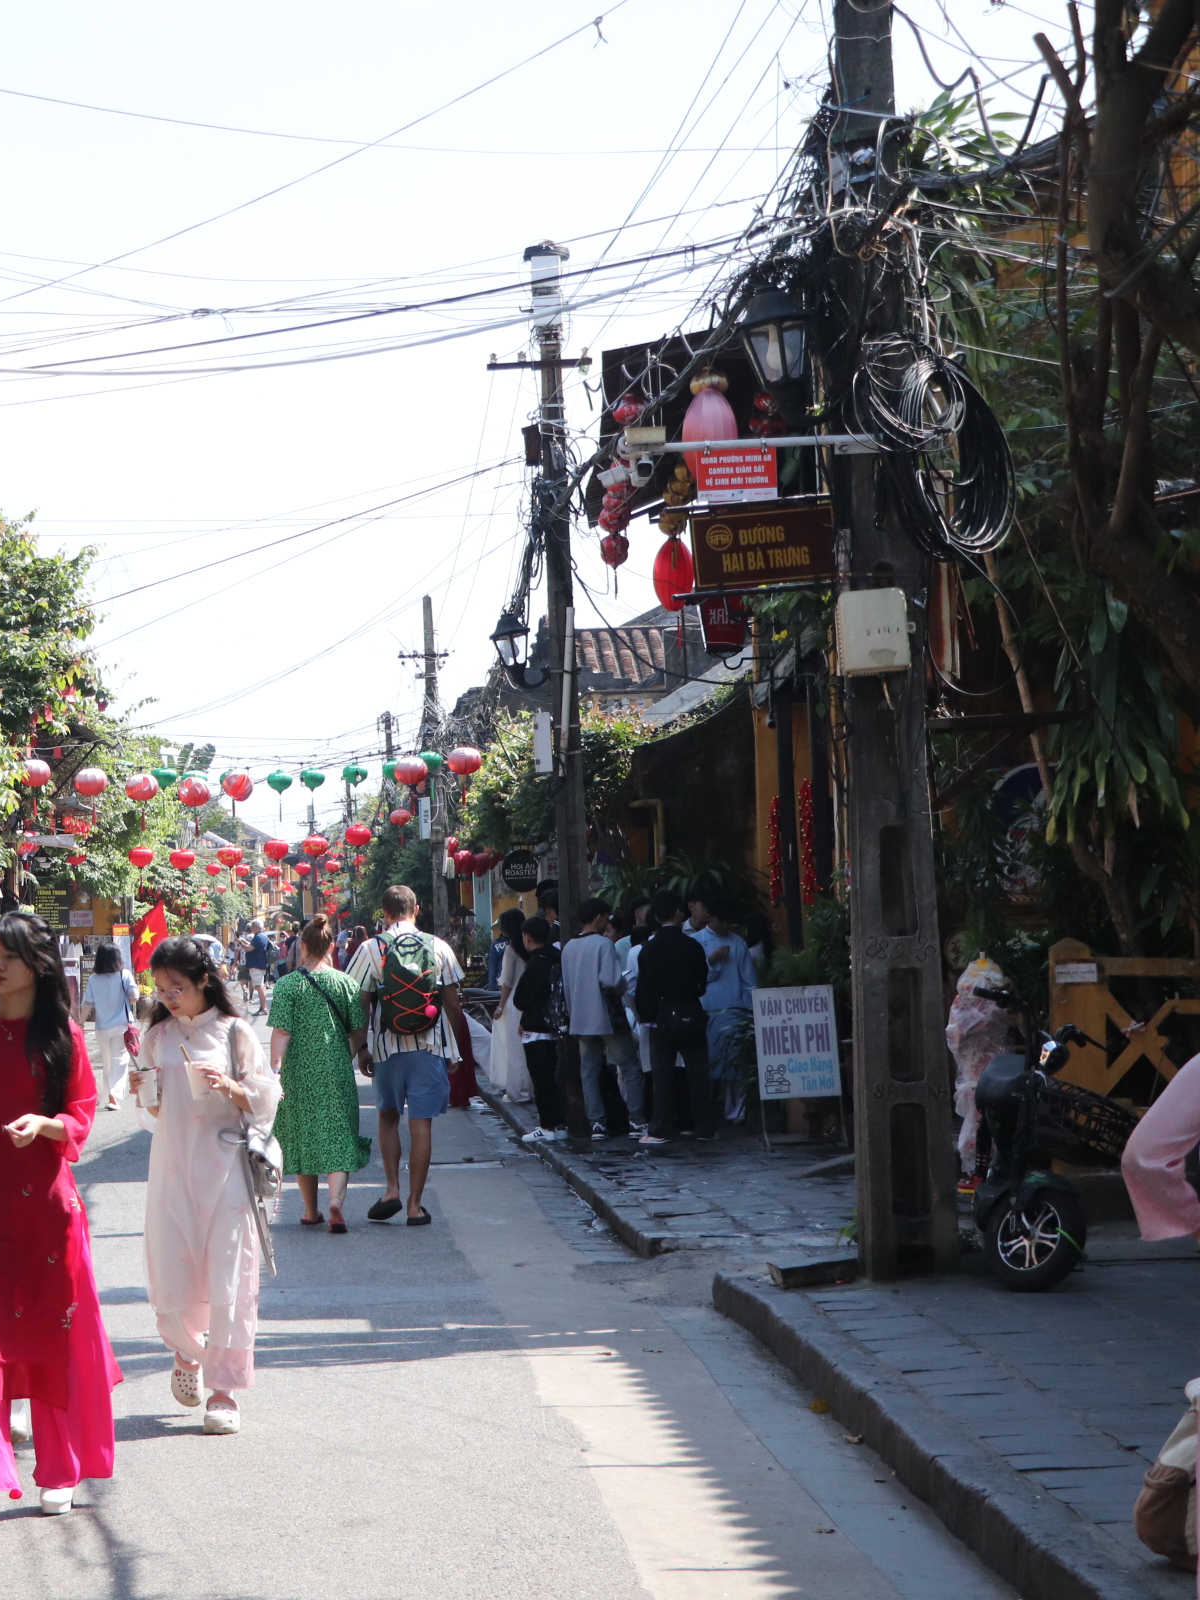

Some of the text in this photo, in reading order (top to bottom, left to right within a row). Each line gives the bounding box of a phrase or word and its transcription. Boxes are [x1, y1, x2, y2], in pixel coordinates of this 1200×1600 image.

[701, 457, 718, 465] UBND
[763, 454, 772, 462] AN
[708, 465, 765, 475] CAMERA GIÁM SÁT
[705, 478, 714, 487] VỆ
[714, 478, 730, 486] SINH
[738, 522, 785, 546] ĐƯỜNG
[722, 546, 810, 573] HAI BÀ TRƯNG
[505, 868, 538, 877] ROASTER
[760, 990, 829, 1020] VẬN CHUYỂN
[762, 1016, 831, 1056] MIỄN PHÍ
[787, 1057, 834, 1074] Giao Hàng
[801, 1075, 818, 1094] Tận
